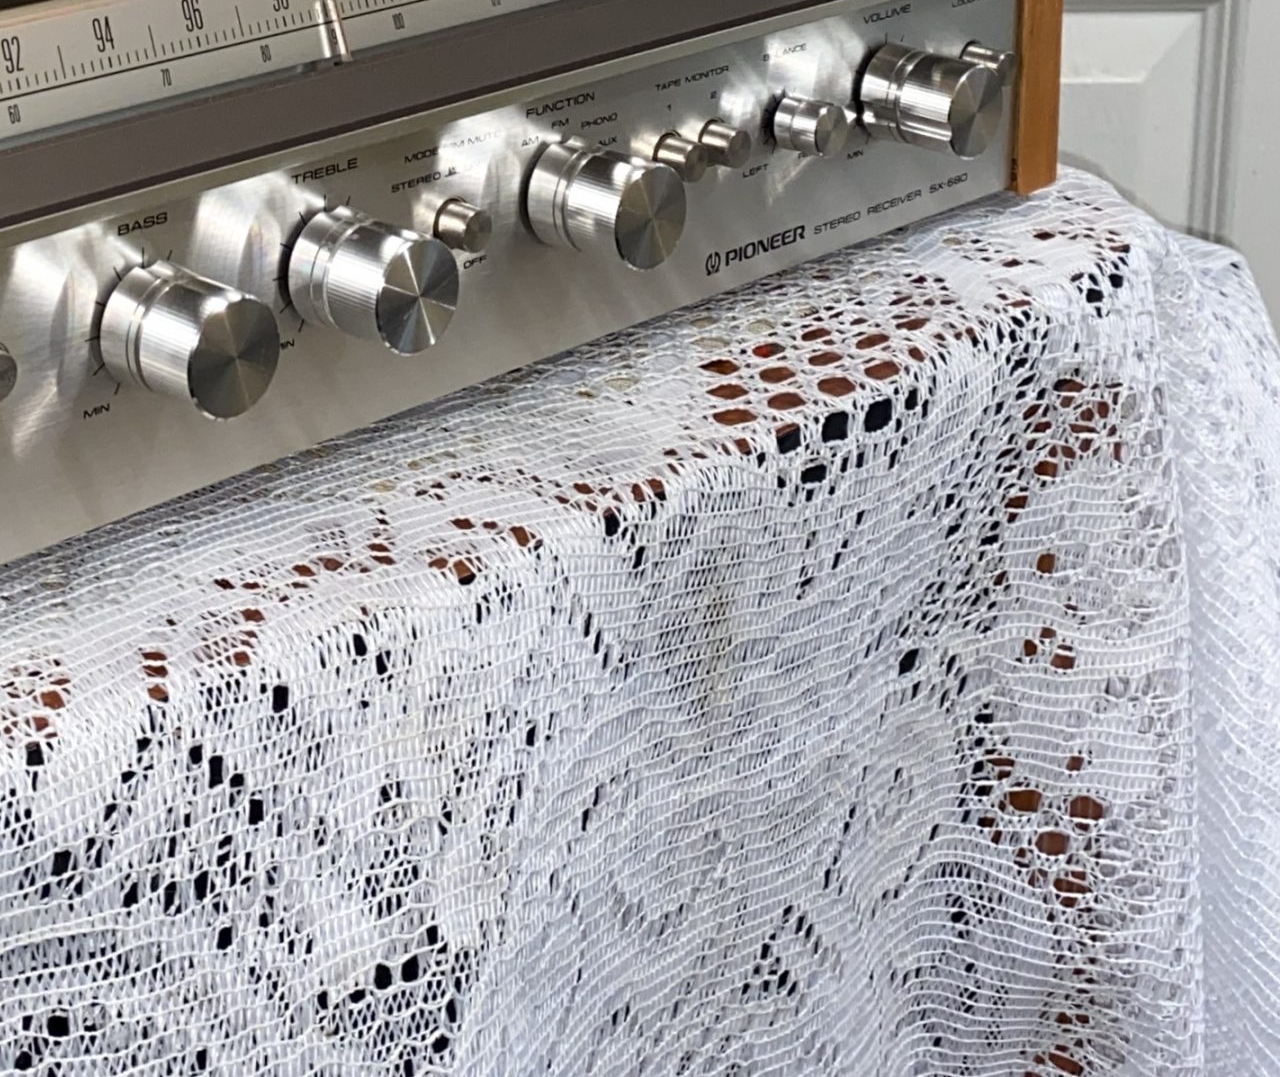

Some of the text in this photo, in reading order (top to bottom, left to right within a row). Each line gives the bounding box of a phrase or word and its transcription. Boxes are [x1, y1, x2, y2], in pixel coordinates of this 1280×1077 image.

[863, 3, 911, 24] VOLUME
[1, 36, 22, 75] 92
[91, 16, 114, 54] 94
[8, 104, 21, 124] 60
[160, 68, 172, 88] 70
[260, 44, 272, 63] 80
[654, 65, 729, 92] TAPE MONITOR
[526, 91, 596, 118] FUNCTION
[551, 112, 618, 130] FM PHONO
[404, 146, 439, 164] MODE
[291, 157, 359, 185] TREBLE
[391, 172, 441, 194] STEREO
[742, 163, 769, 178] LEFT
[117, 211, 168, 237] BASS
[725, 172, 969, 267] PIONEER STEREO RECEIVER SX-680
[83, 403, 110, 420] MIN
